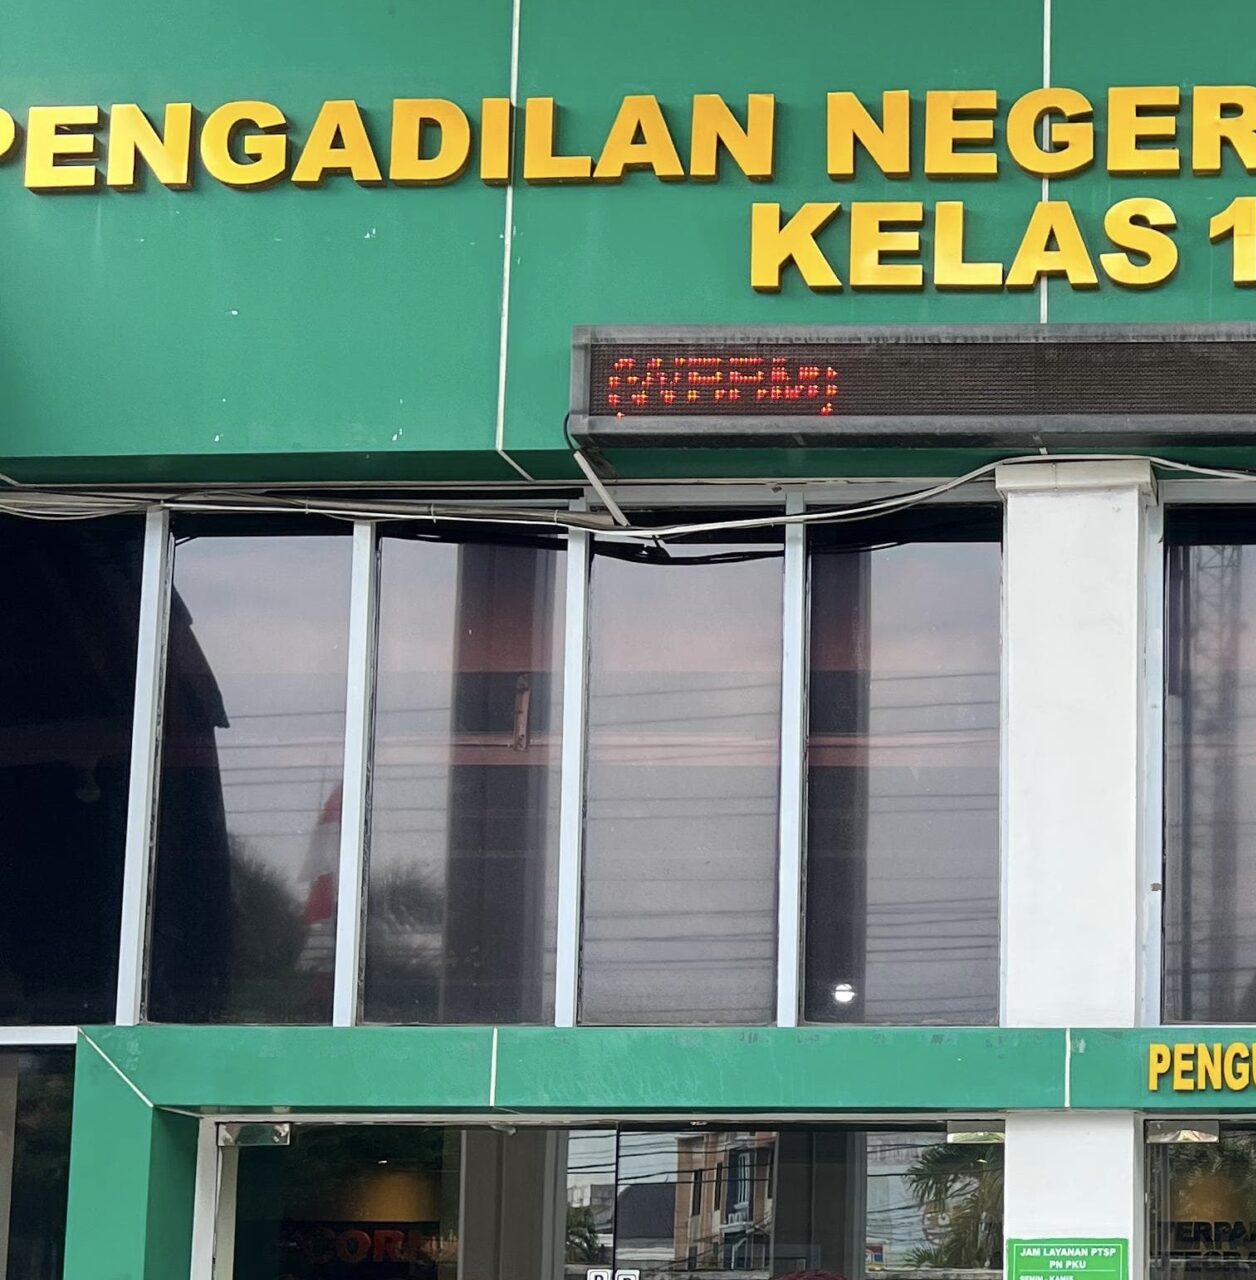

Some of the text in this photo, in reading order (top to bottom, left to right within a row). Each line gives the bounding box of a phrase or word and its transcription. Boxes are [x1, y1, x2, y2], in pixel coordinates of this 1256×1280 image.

[0, 93, 777, 191] ENGADILAN
[750, 198, 1181, 290] KELAS
[1020, 1248, 1117, 1257] JAM LAYANAN PTSP
[1050, 1261, 1087, 1269] PN PKU
